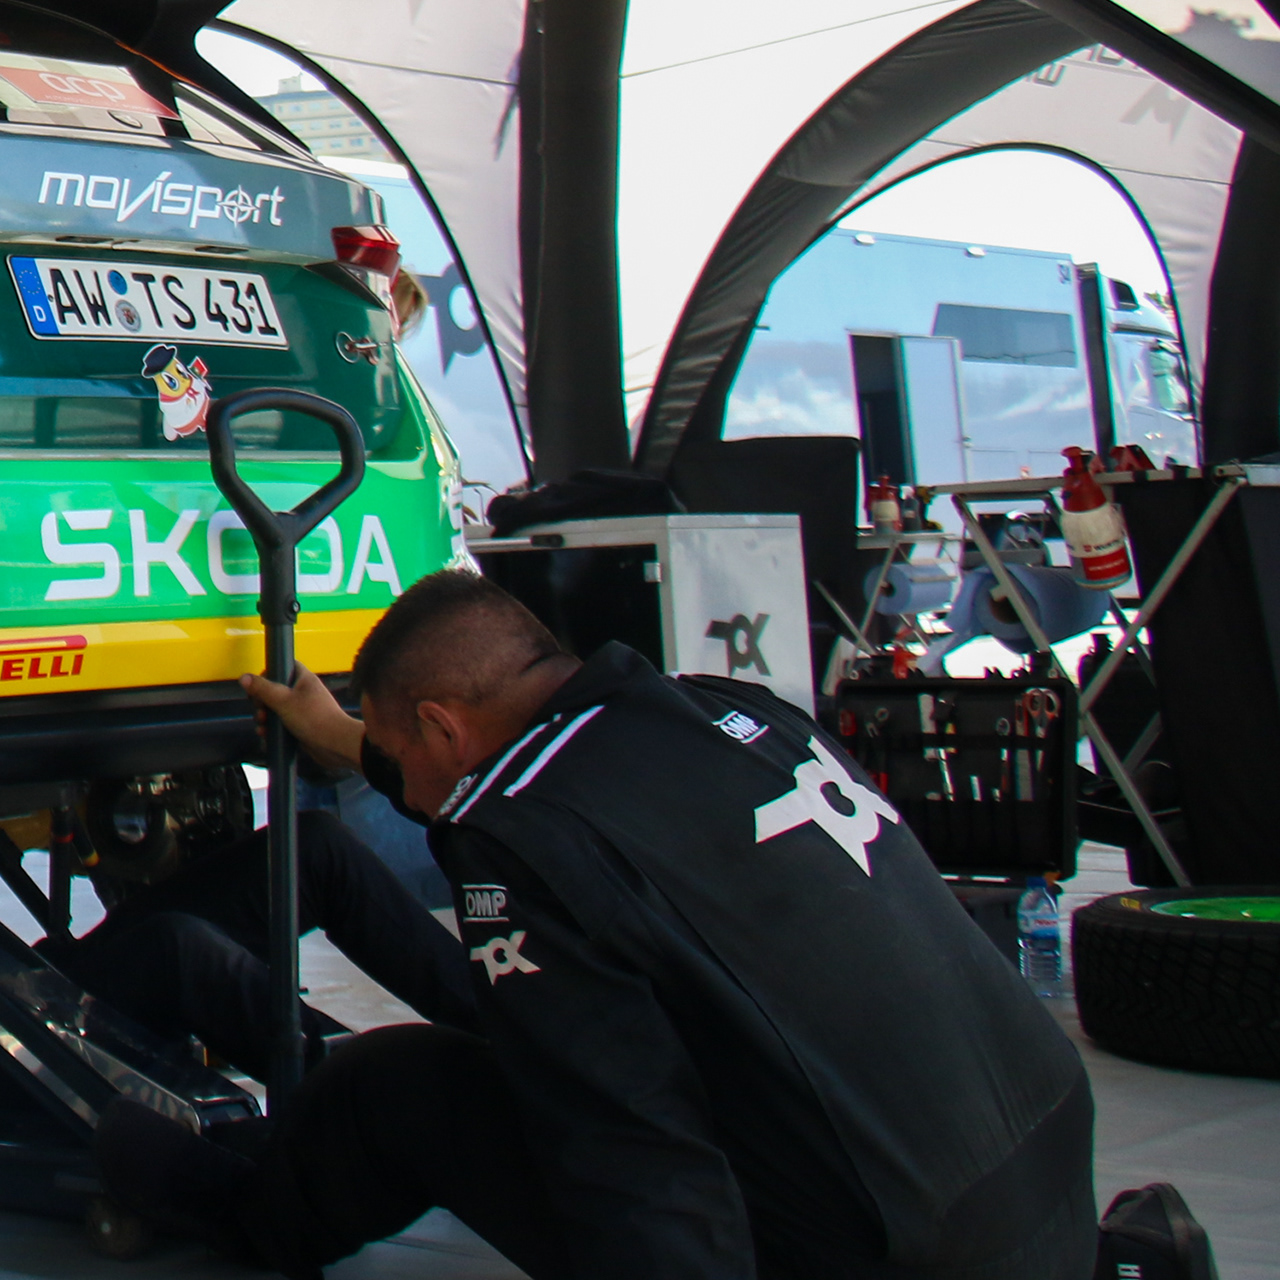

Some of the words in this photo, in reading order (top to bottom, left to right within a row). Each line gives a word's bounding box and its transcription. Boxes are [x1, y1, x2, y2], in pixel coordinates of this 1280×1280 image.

[50, 268, 107, 327] AW
[131, 272, 196, 331] TS
[205, 279, 278, 337] 431
[41, 508, 402, 602] SKODA
[719, 715, 763, 741] OMP
[464, 889, 506, 917] OMP
